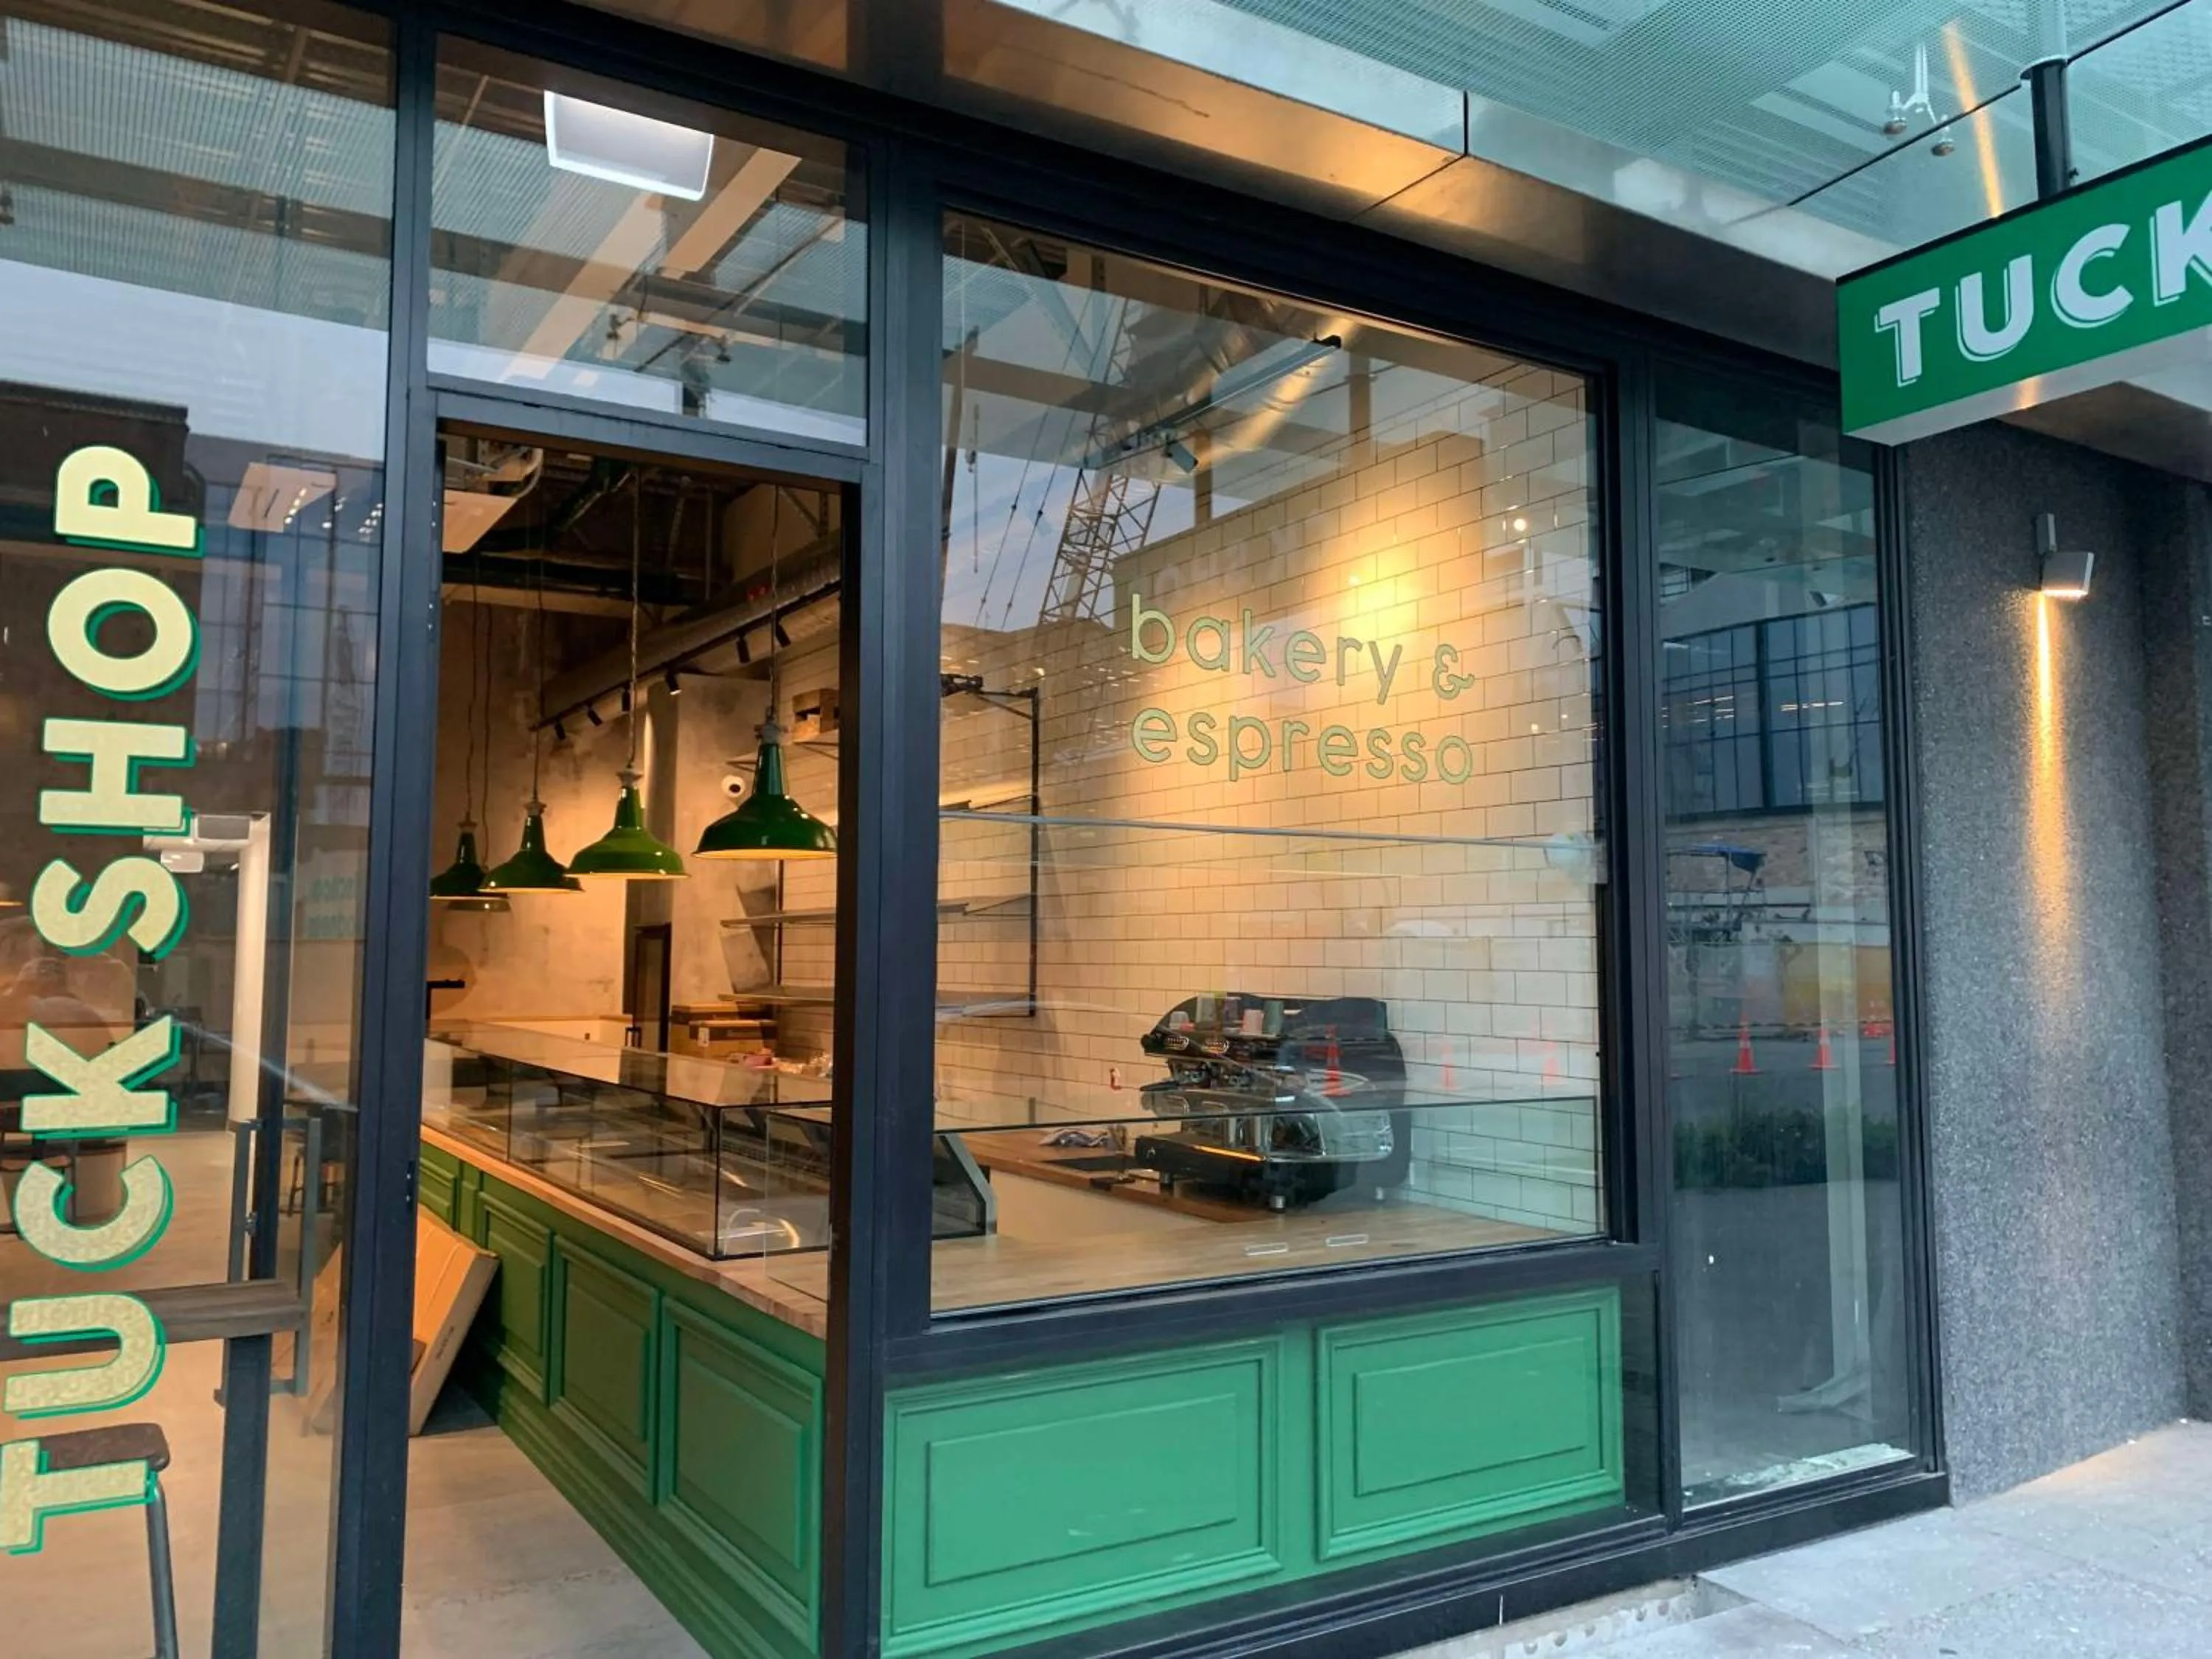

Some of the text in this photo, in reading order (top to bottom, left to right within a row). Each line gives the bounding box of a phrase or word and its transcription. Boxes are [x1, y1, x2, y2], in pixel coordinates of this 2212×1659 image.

[1874, 191, 2212, 388] TUCK
[1130, 593, 1475, 705] bakery &
[1131, 707, 1473, 785] espresso
[0, 445, 206, 1555] TUCK SHOP
